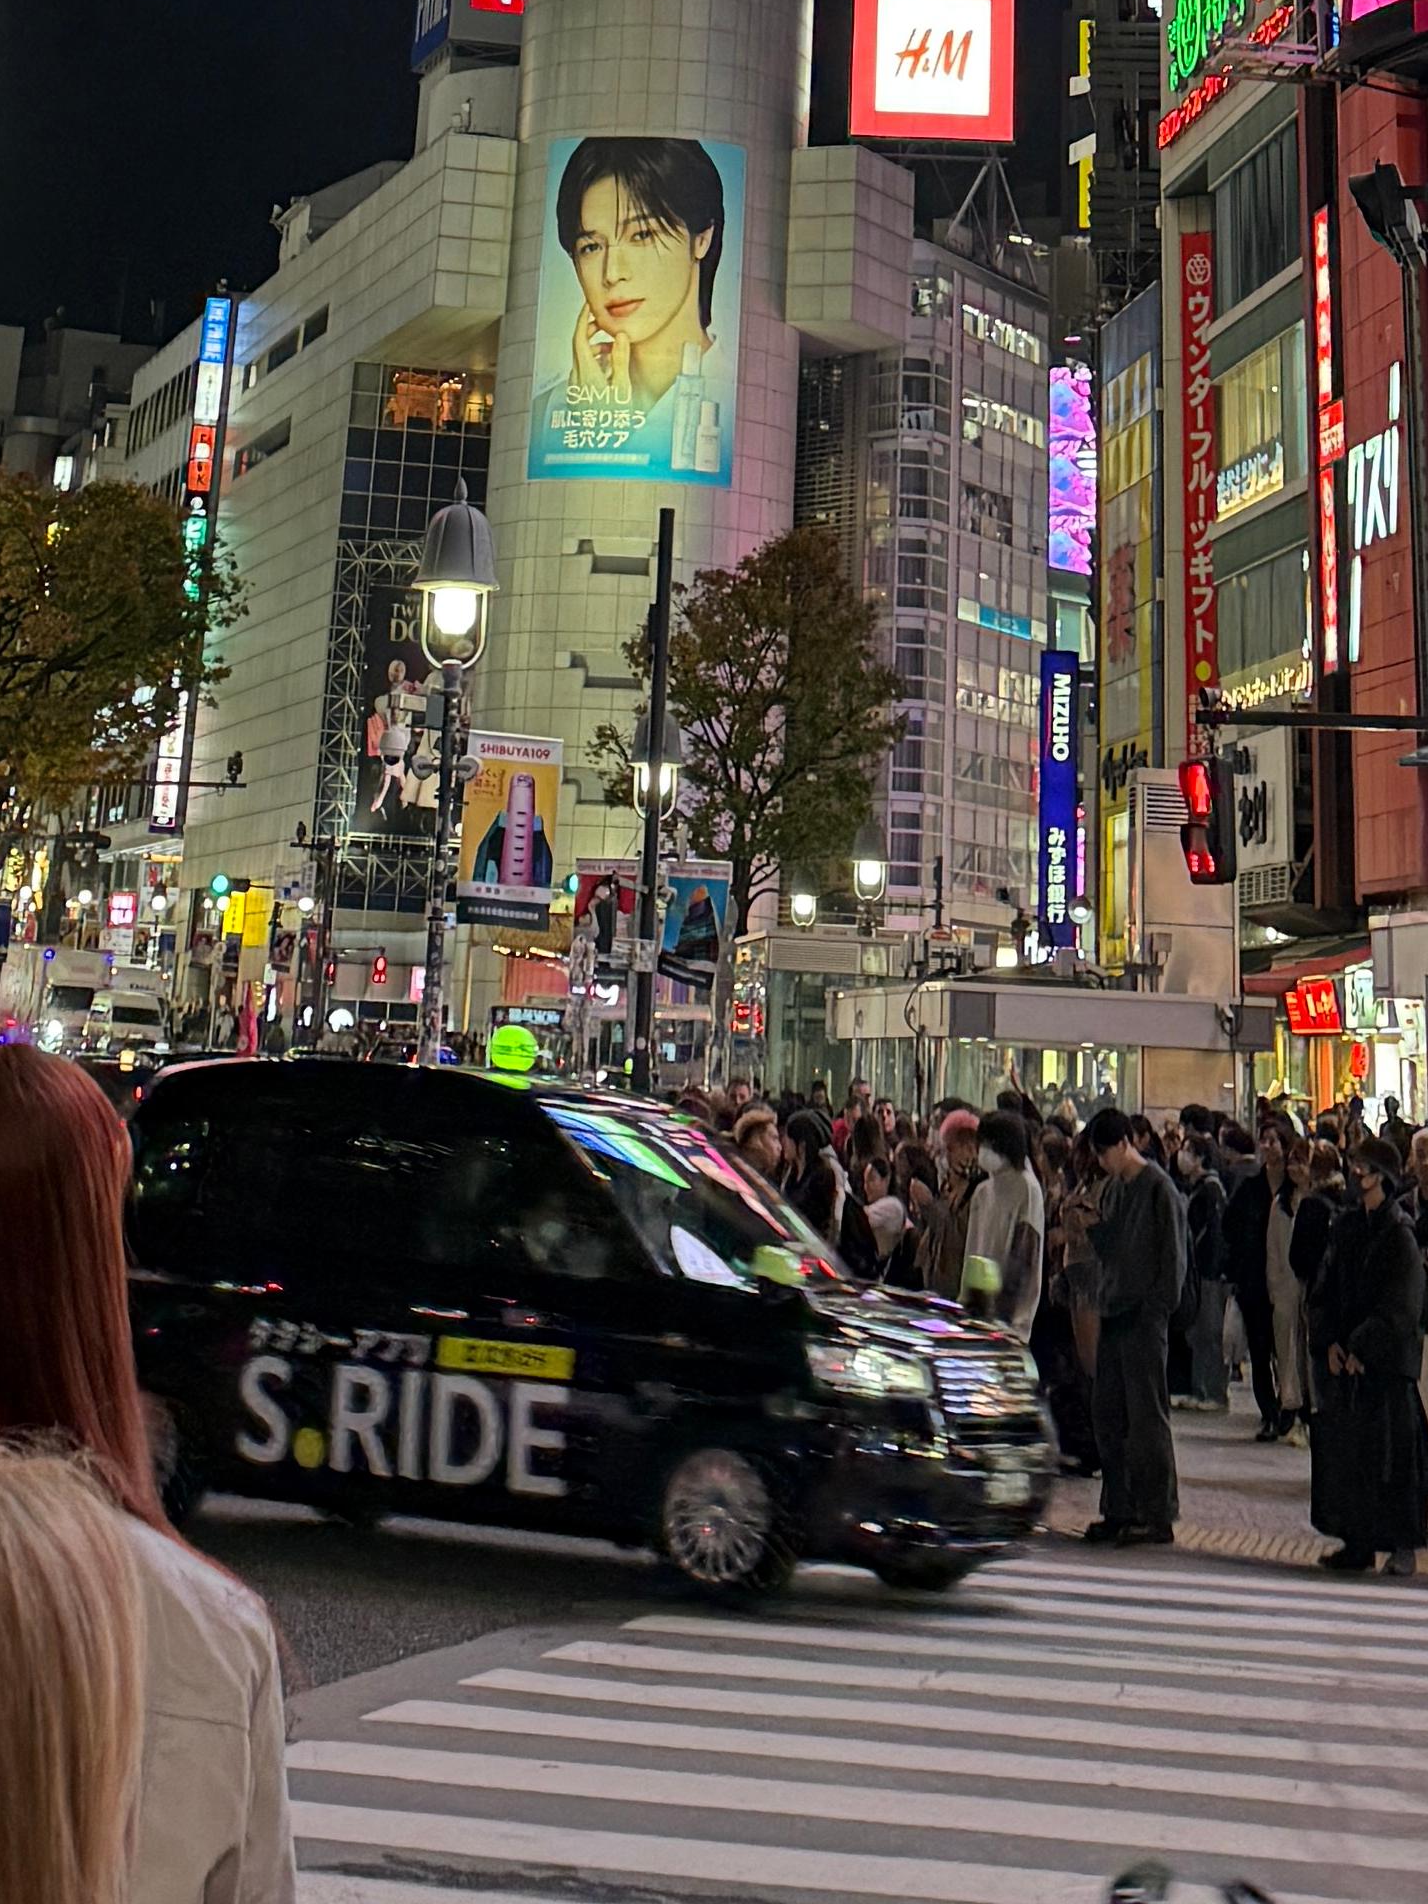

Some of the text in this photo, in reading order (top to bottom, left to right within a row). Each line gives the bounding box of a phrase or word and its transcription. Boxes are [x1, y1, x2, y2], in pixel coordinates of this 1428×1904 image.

[895, 27, 974, 83] H&M
[550, 409, 647, 430] 肌に寄り添う
[563, 429, 630, 450] 毛穴ケア
[1052, 671, 1072, 763] MIZUHO
[479, 742, 551, 761] SHIBUYA109
[1045, 827, 1069, 924] みずほ銀行
[237, 1354, 572, 1496] S.RIDE
